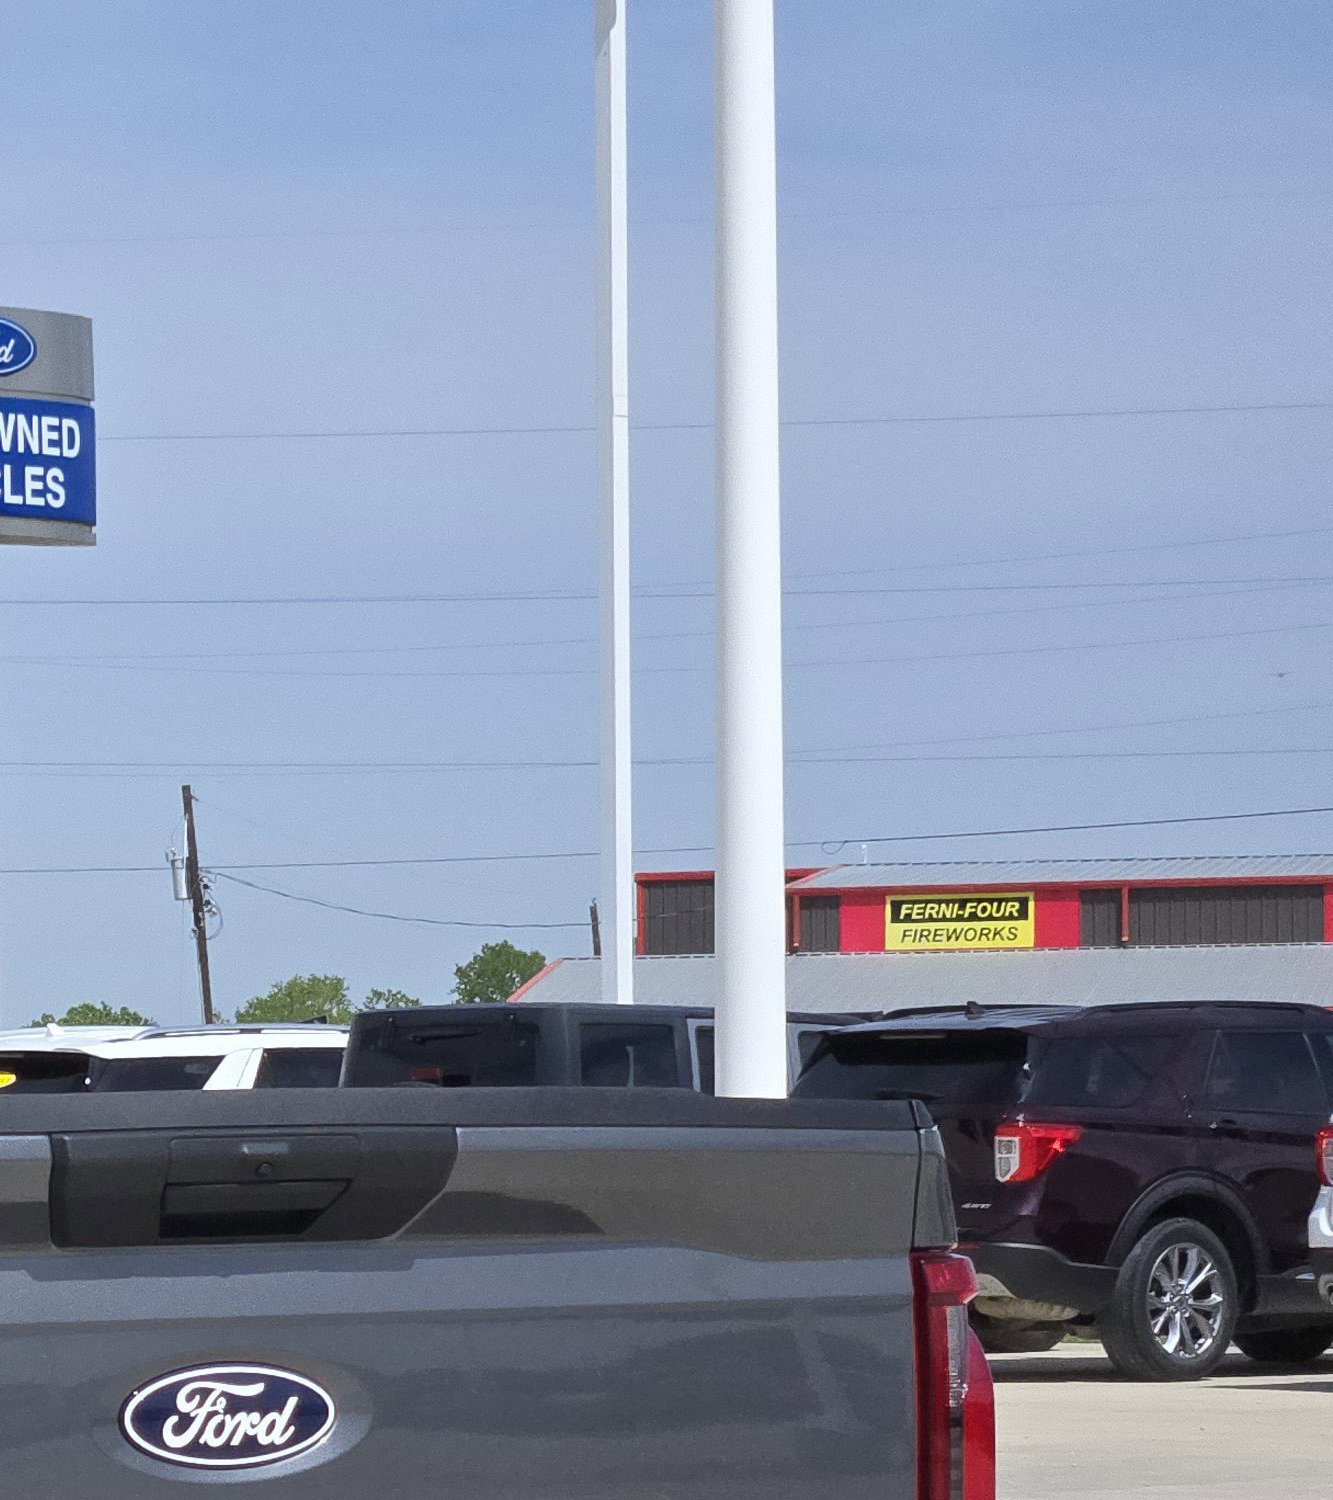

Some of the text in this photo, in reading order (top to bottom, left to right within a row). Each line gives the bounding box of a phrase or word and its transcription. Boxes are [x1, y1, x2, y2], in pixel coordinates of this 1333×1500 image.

[899, 902, 1020, 920] FERNI-FOUR
[901, 926, 1019, 943] FIREWORKS
[162, 1381, 299, 1448] Ford
